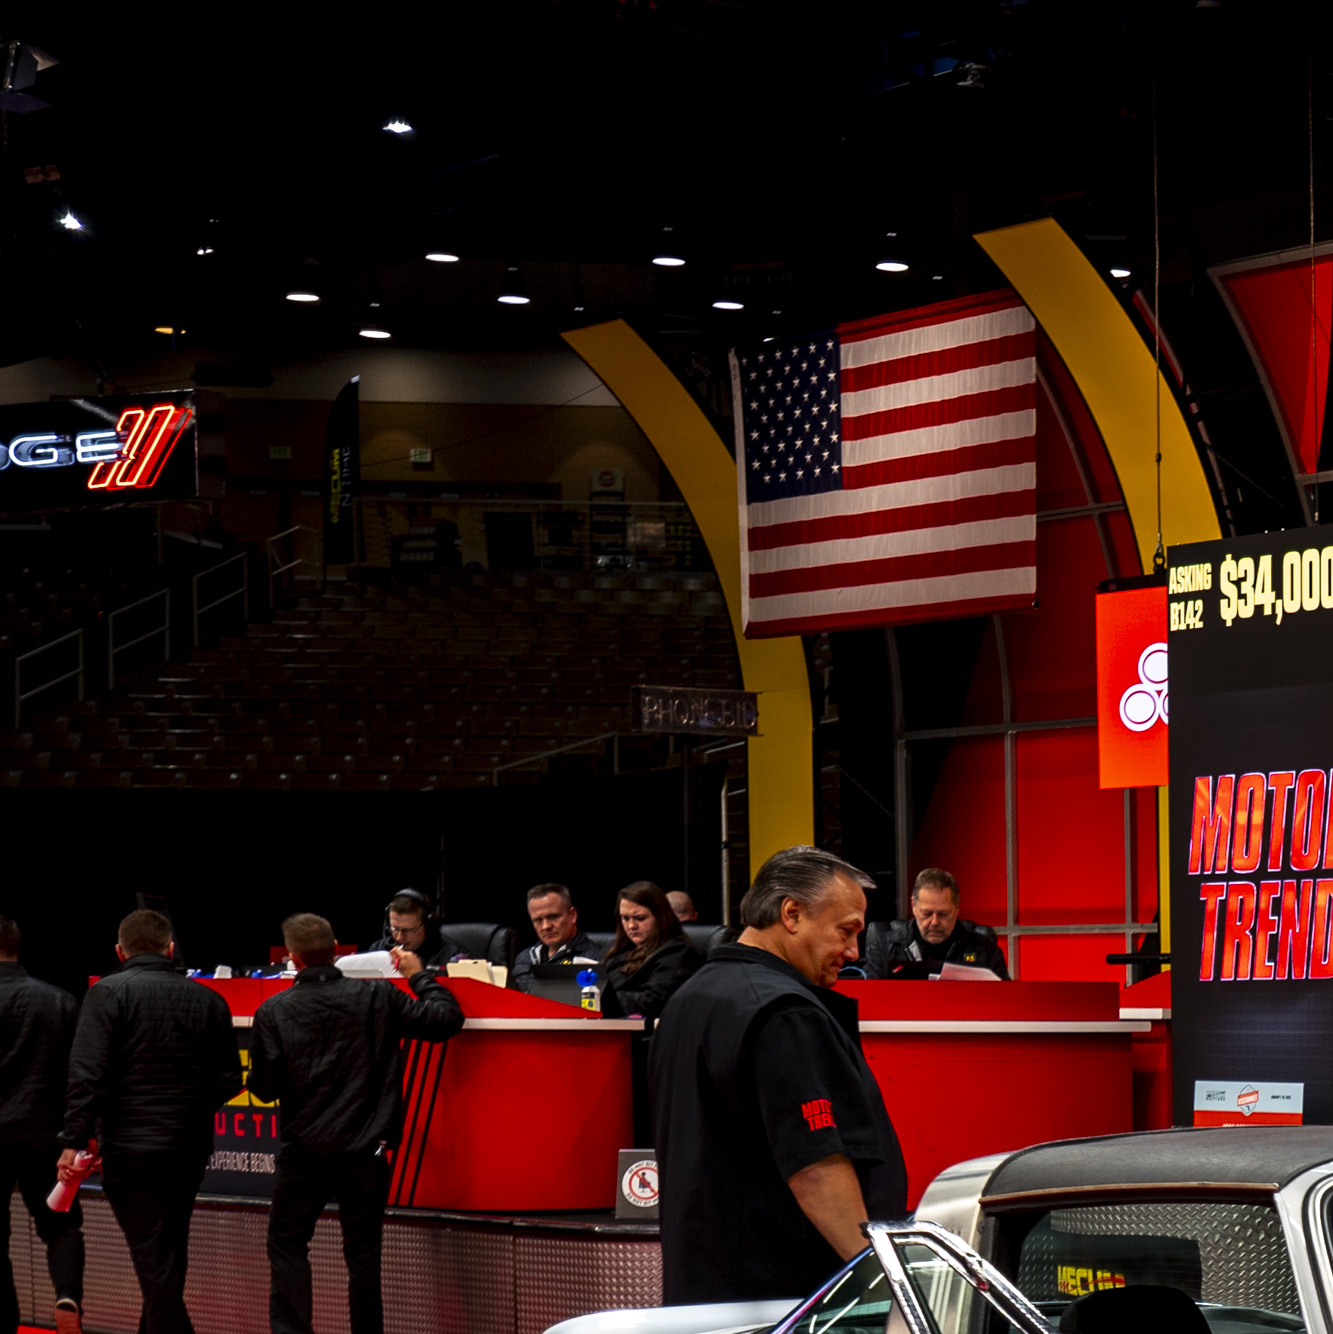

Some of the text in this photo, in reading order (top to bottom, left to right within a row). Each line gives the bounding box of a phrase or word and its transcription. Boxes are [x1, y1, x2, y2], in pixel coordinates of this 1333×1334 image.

[0, 429, 129, 470] GE
[1168, 563, 1212, 594] ASKING
[1170, 599, 1204, 631] B142
[211, 1151, 276, 1175] EXPERIENCE BEGINS
